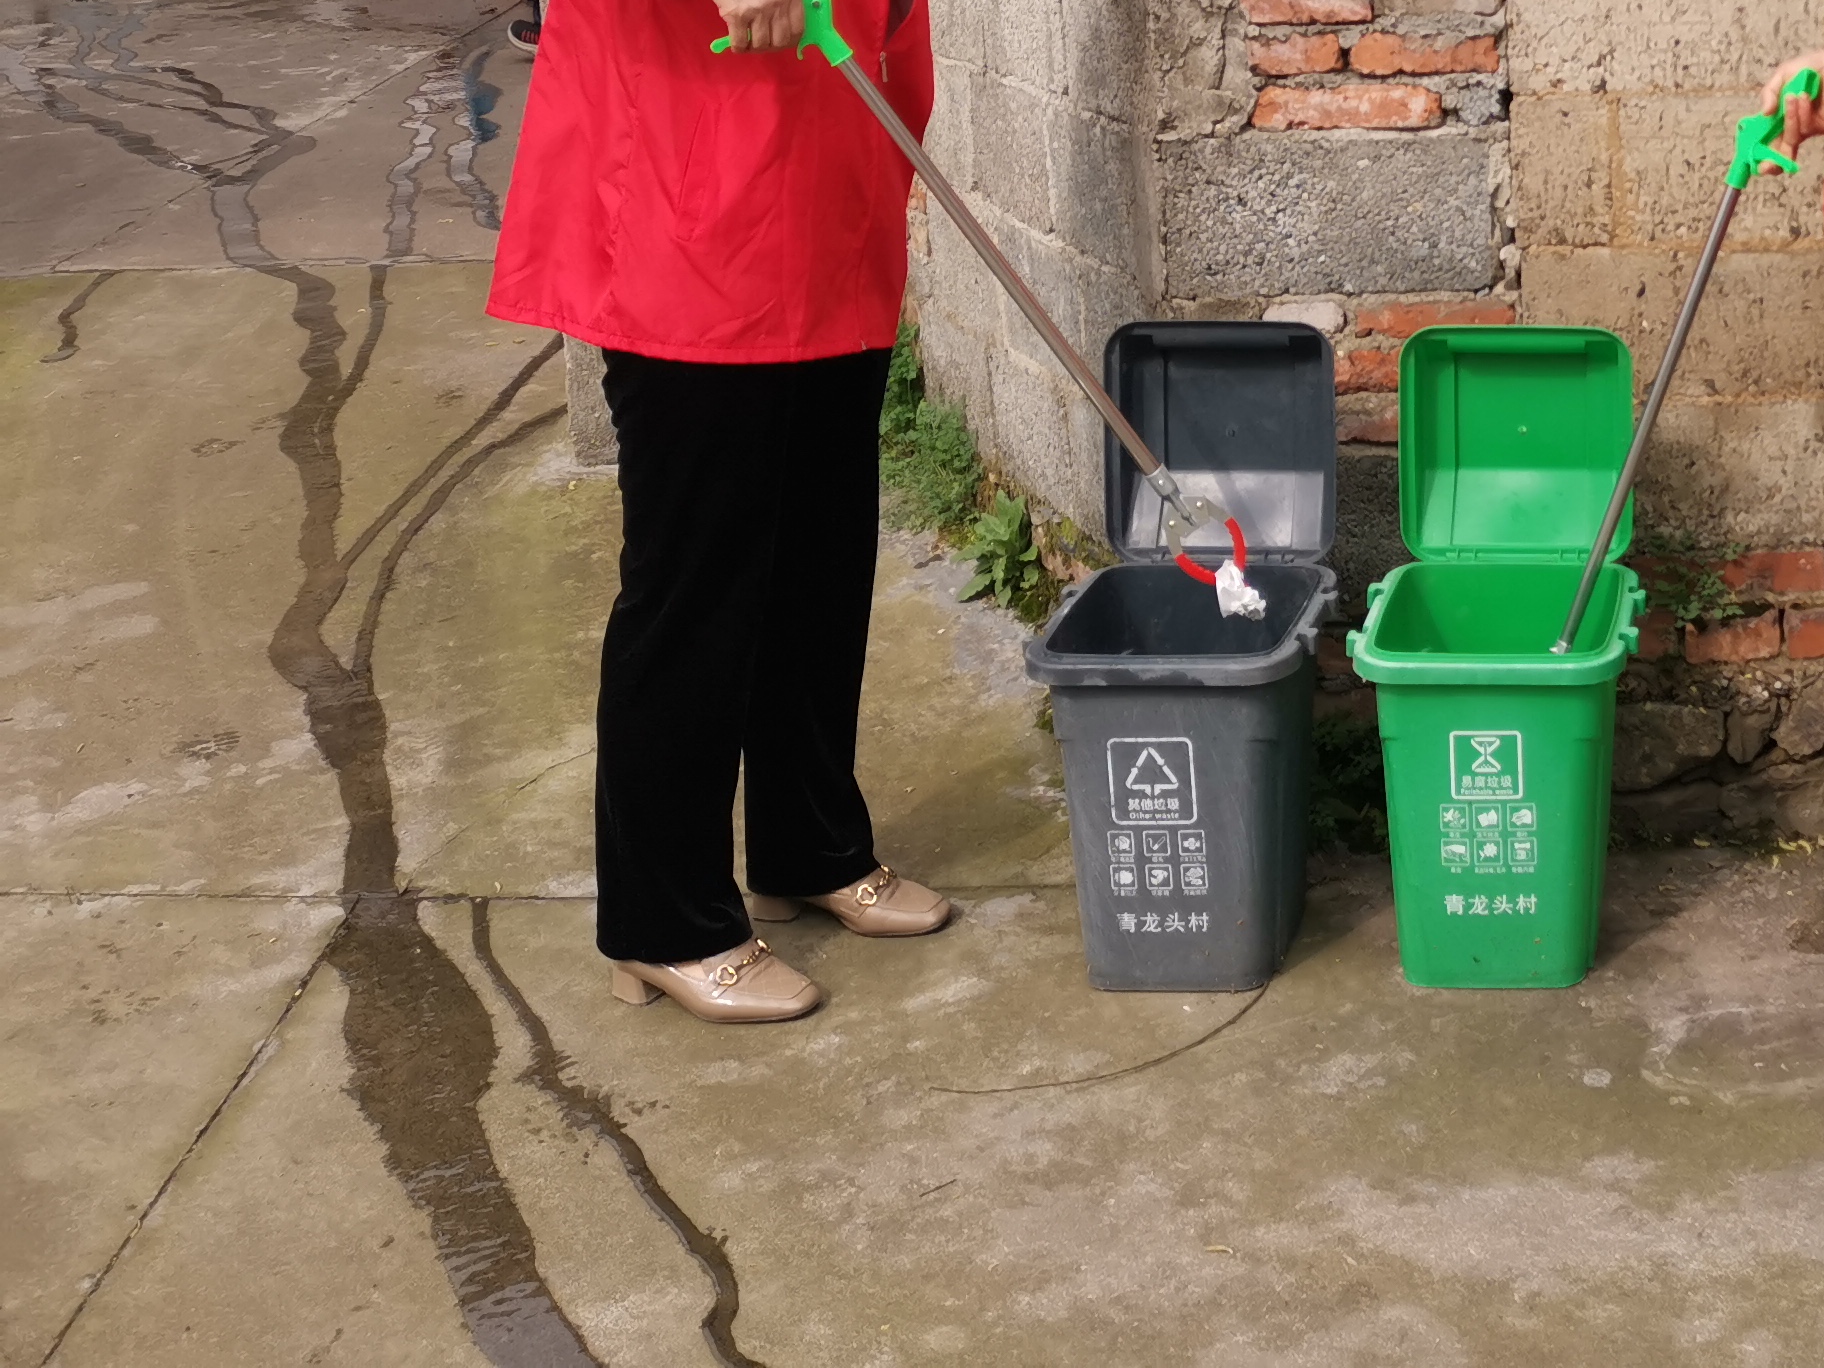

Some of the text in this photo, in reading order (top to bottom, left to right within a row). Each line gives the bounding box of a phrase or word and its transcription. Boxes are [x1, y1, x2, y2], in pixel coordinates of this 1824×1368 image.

[1461, 775, 1513, 788] 易腐垃圾
[1127, 798, 1180, 811] 其他垃圾
[1444, 894, 1537, 915] 青龙头村
[1116, 912, 1210, 933] 青龙头村
